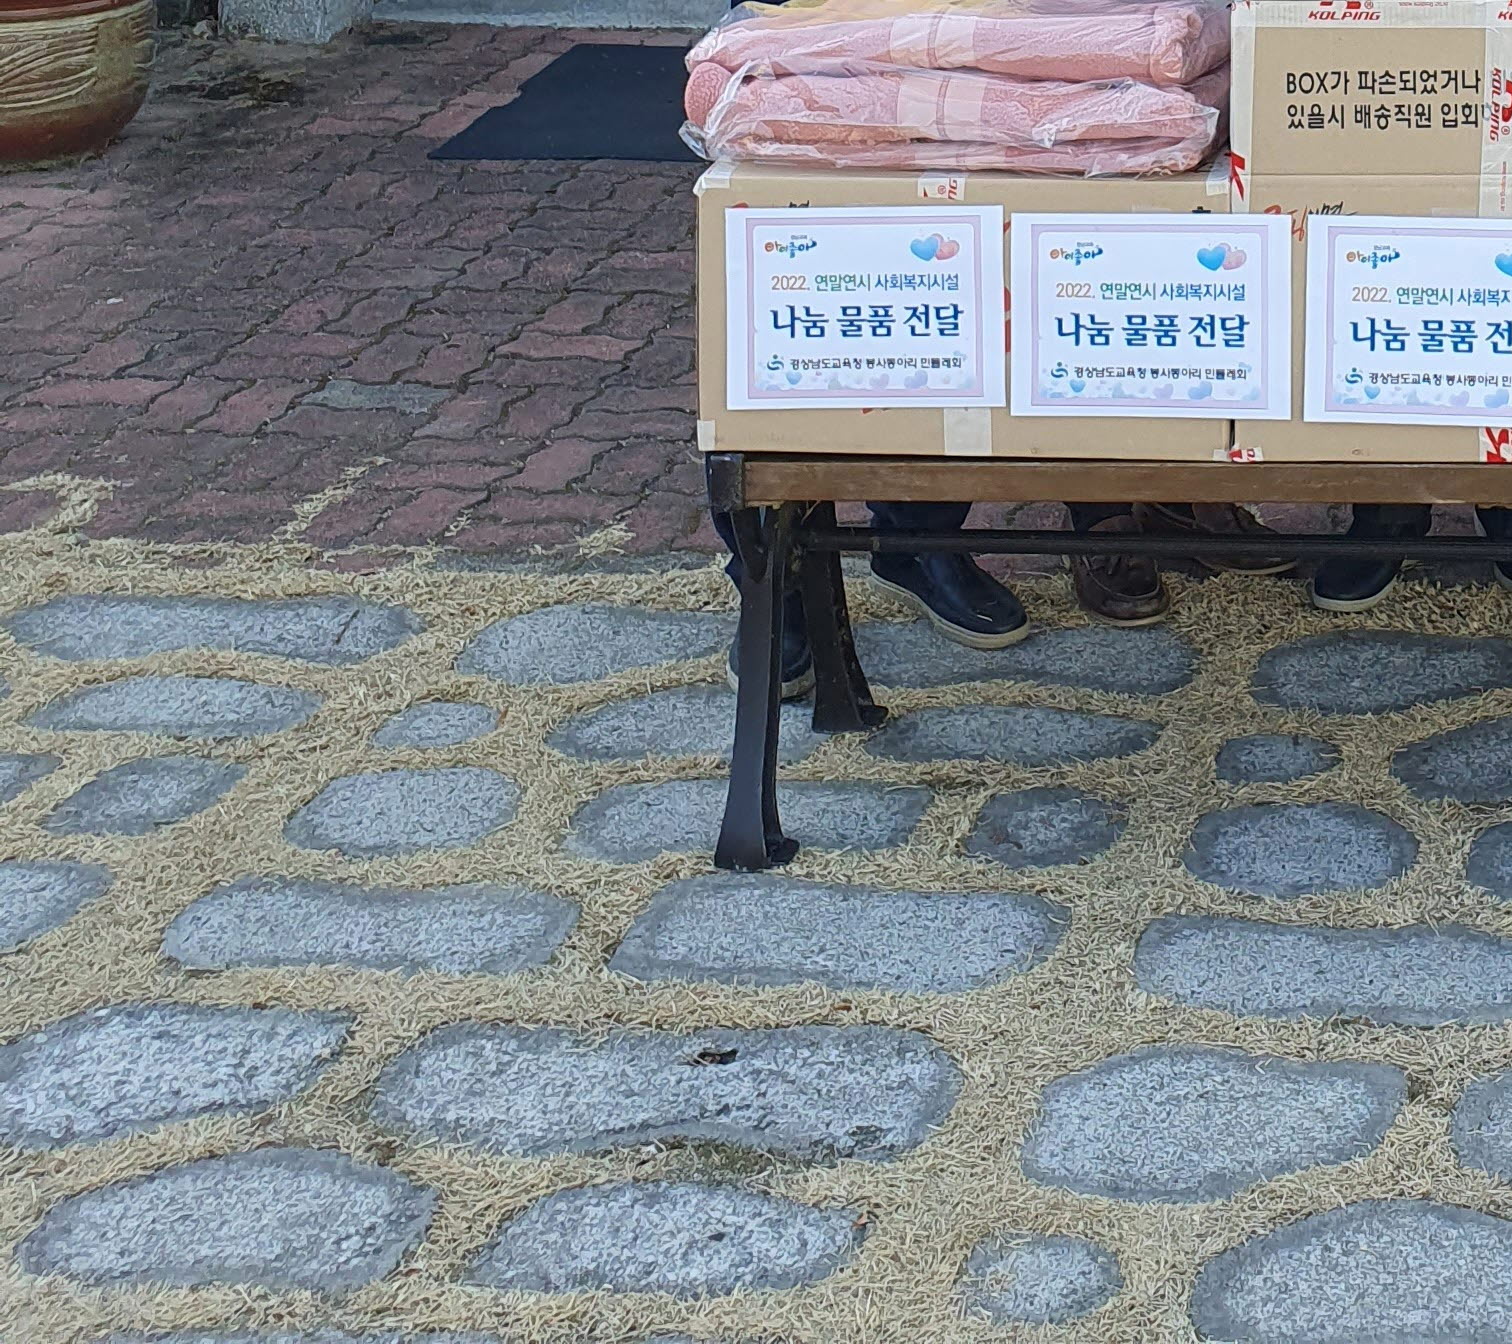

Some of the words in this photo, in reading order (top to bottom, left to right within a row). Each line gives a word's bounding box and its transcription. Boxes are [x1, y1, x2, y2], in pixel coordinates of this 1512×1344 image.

[1308, 11, 1381, 21] KOLPING
[1286, 73, 1349, 95] BOX가
[1358, 70, 1481, 94] 파손되었거나
[1287, 105, 1346, 129] 있을시
[1355, 104, 1433, 129] 배송직원
[1489, 68, 1502, 141] KOLPING
[771, 275, 810, 292] 2022.
[815, 273, 871, 292] 연말연시
[875, 273, 959, 292] 사회복지시설
[1056, 282, 1095, 299] 2022.
[1099, 282, 1156, 301] 연말연시
[1160, 282, 1246, 301] 사회복지시설
[1352, 286, 1391, 303] 2022.
[1396, 286, 1454, 305] 연말연시
[770, 305, 829, 339] 나눔
[836, 305, 895, 338] 물품
[903, 302, 964, 337] 전달
[1054, 312, 1114, 347] 나눔
[1121, 313, 1181, 347] 물품
[1188, 312, 1249, 348] 전달
[1350, 317, 1410, 352] 나눔
[1418, 319, 1478, 354] 물품
